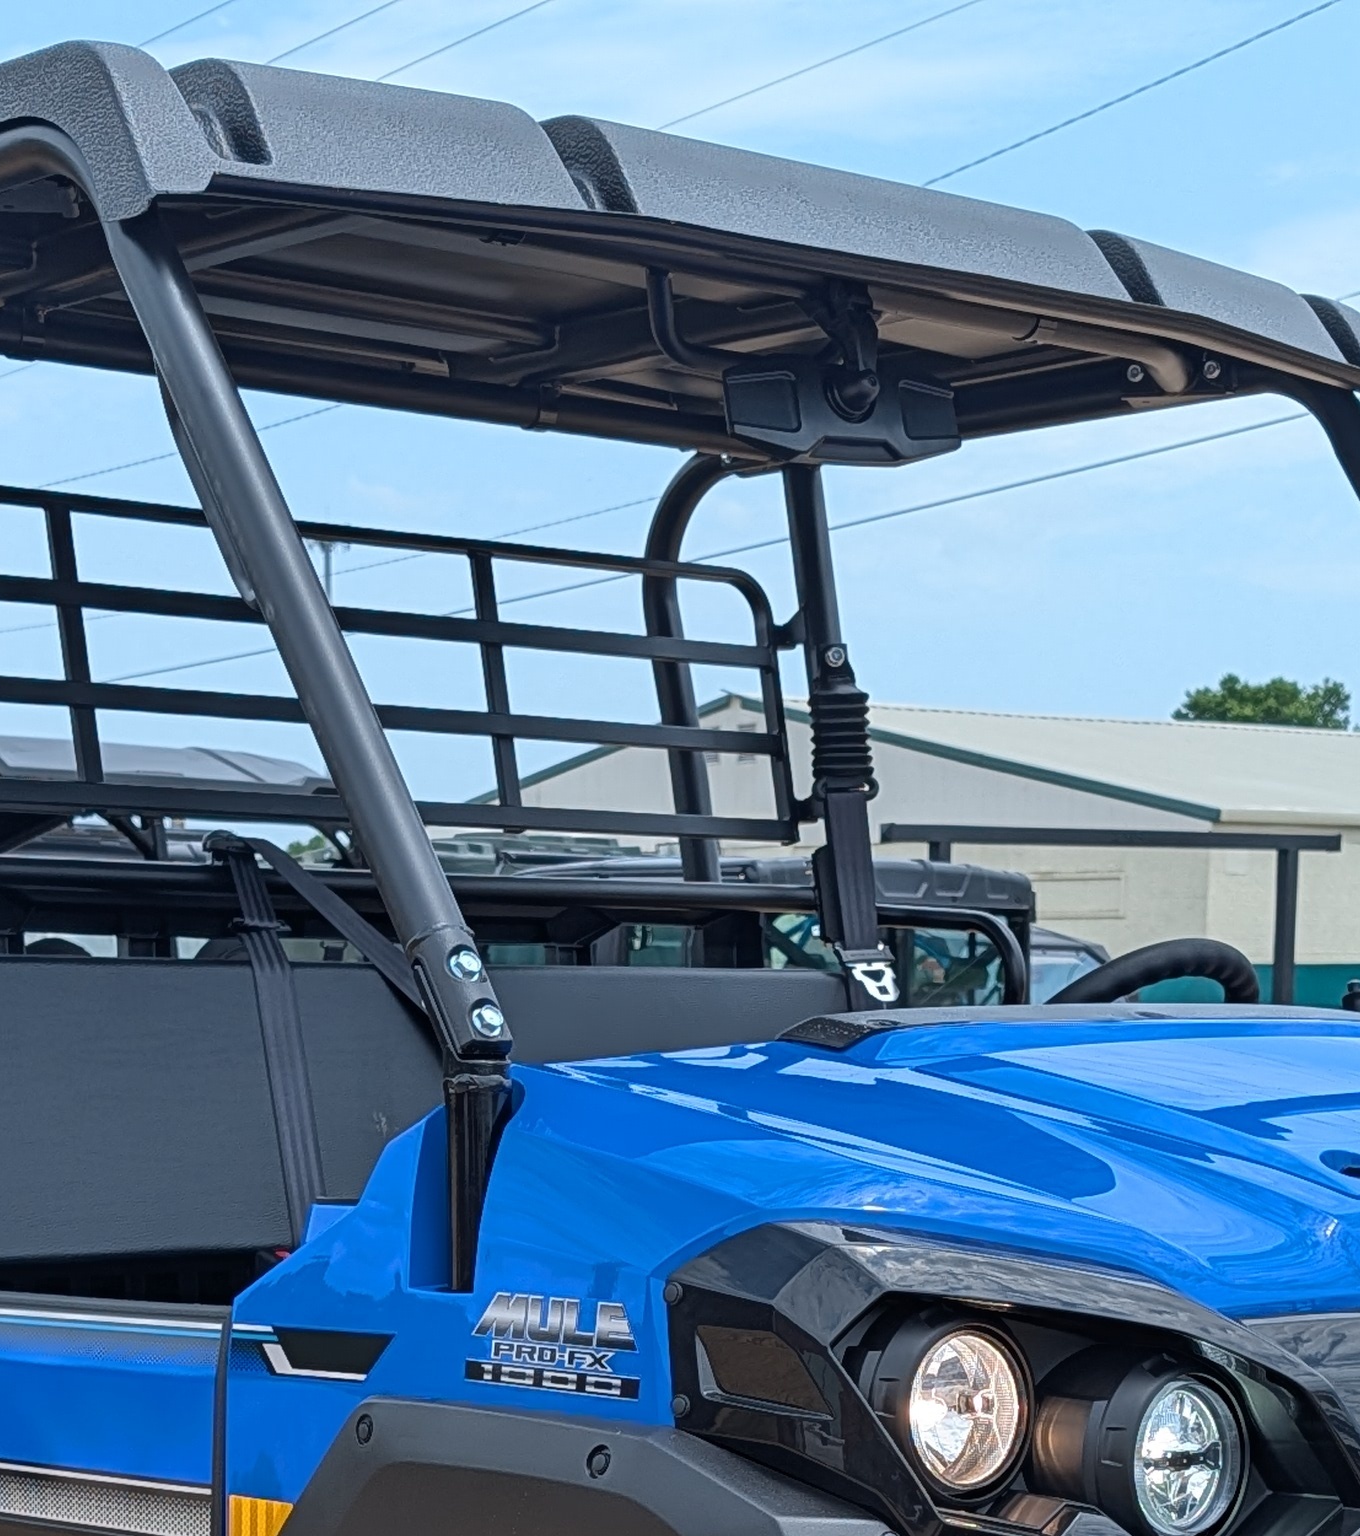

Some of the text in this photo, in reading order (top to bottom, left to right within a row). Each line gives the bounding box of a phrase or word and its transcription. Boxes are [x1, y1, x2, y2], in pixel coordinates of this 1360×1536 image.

[471, 1291, 640, 1354] MULE
[490, 1339, 616, 1373] PRO-FX
[480, 1364, 623, 1397] 1000
